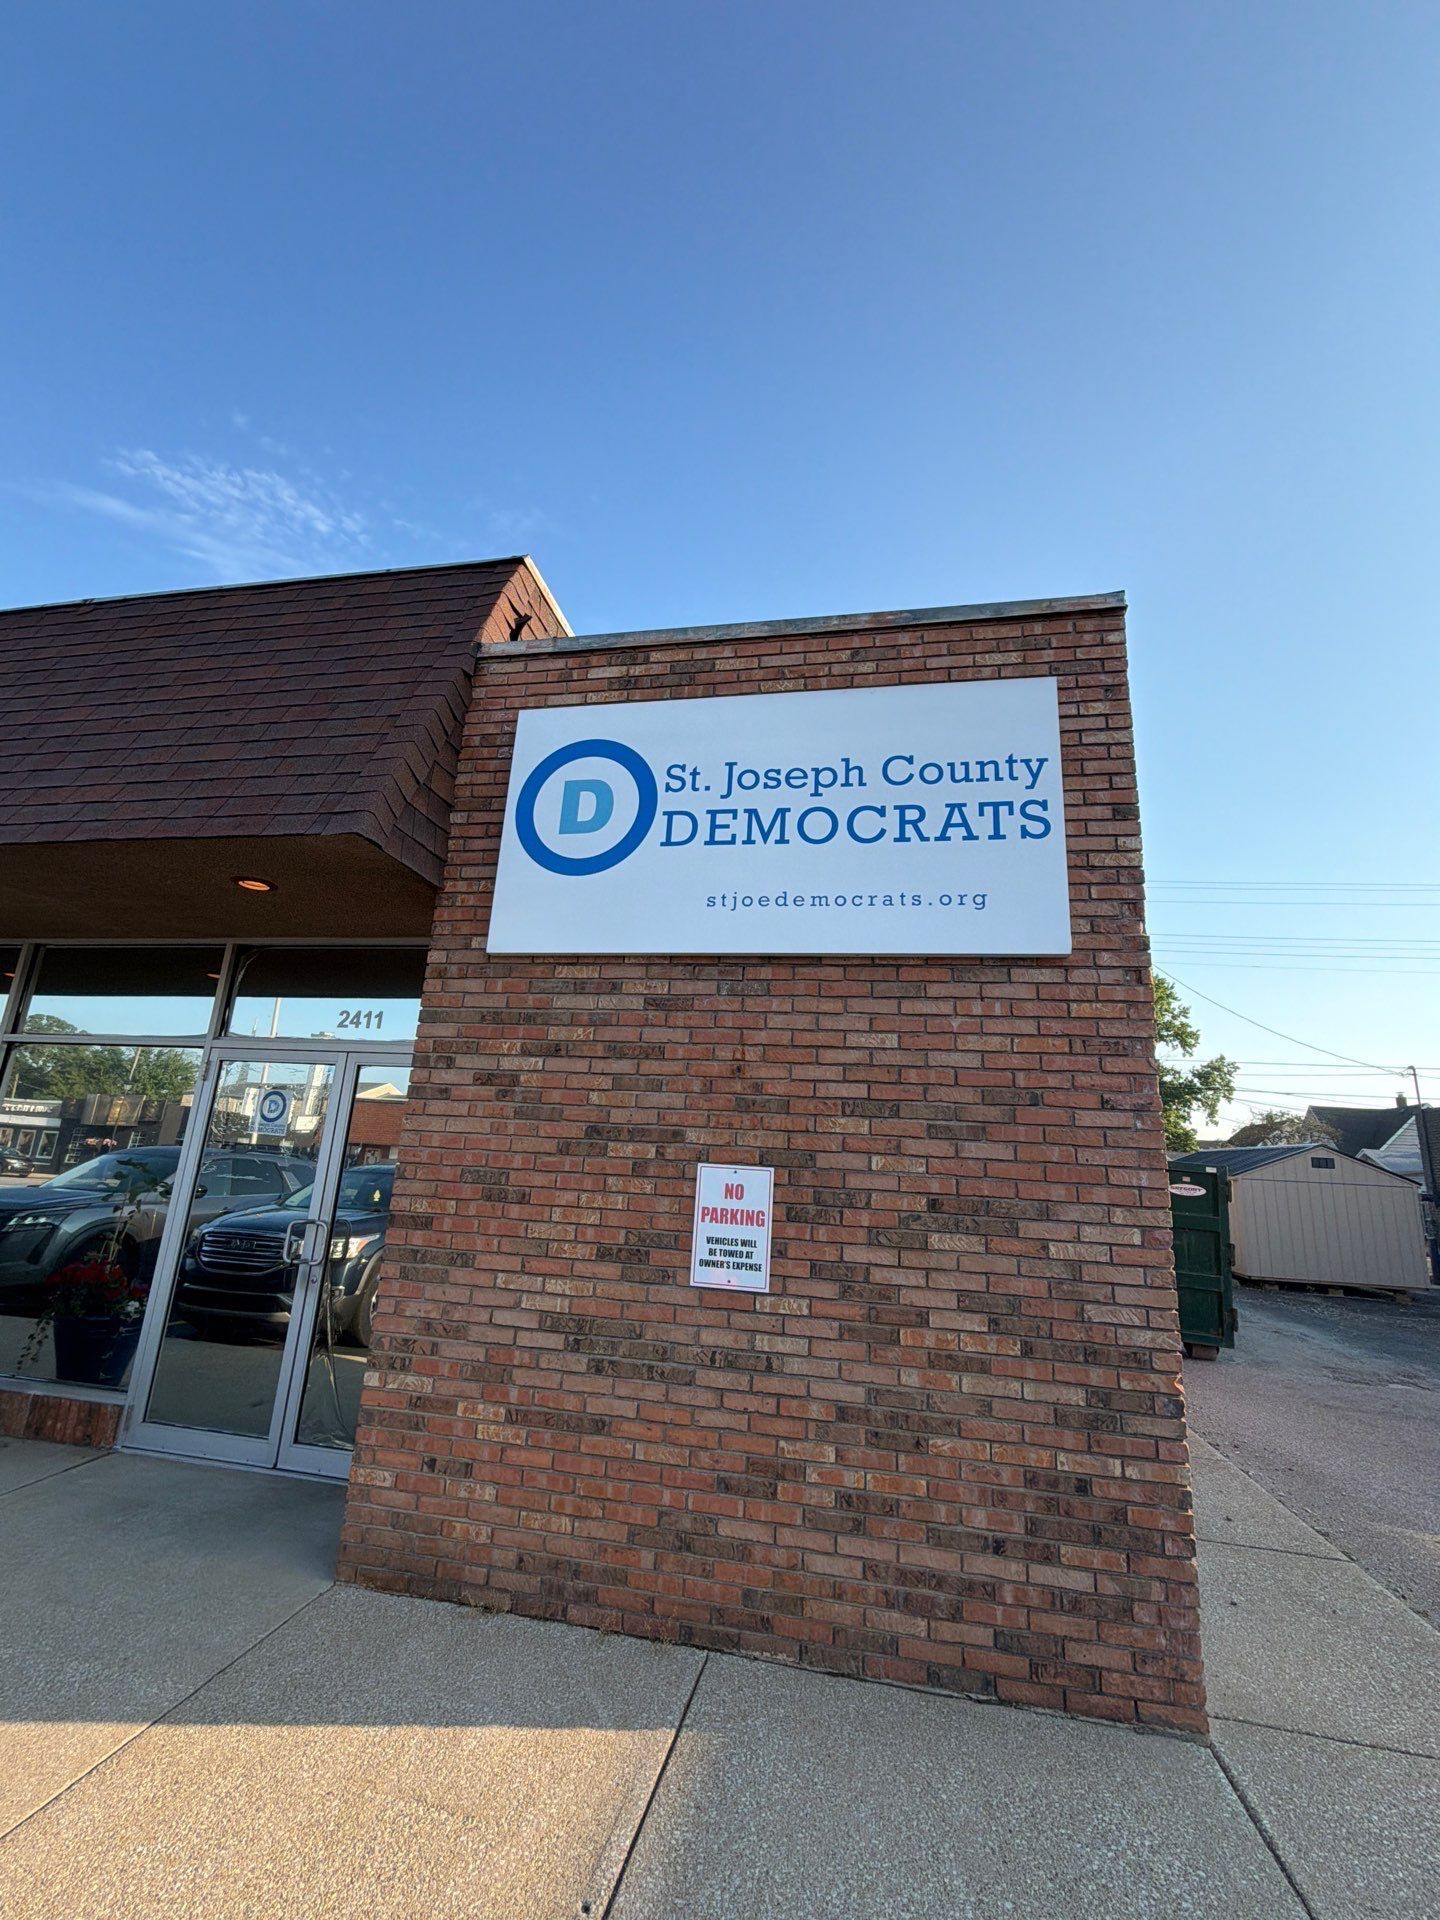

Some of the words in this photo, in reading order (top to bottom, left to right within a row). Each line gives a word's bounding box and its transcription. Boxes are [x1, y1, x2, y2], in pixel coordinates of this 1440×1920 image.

[664, 763, 711, 793] St.
[720, 757, 867, 799] Joseph
[881, 753, 1049, 790] County
[558, 779, 615, 835] D
[660, 798, 1052, 847] DEMOCRATS
[706, 891, 988, 911] stjoedemocrats.org
[336, 1010, 384, 1029] 2411
[724, 1183, 745, 1201] NO
[700, 1206, 766, 1227] PARKING
[706, 1236, 739, 1247] VEHICLES
[740, 1239, 757, 1248] WILL
[708, 1248, 718, 1257] BE
[719, 1248, 744, 1259] TOWED
[745, 1251, 754, 1260] AT
[698, 1258, 731, 1269] OWNER'S
[732, 1261, 762, 1272] EXPENSE
